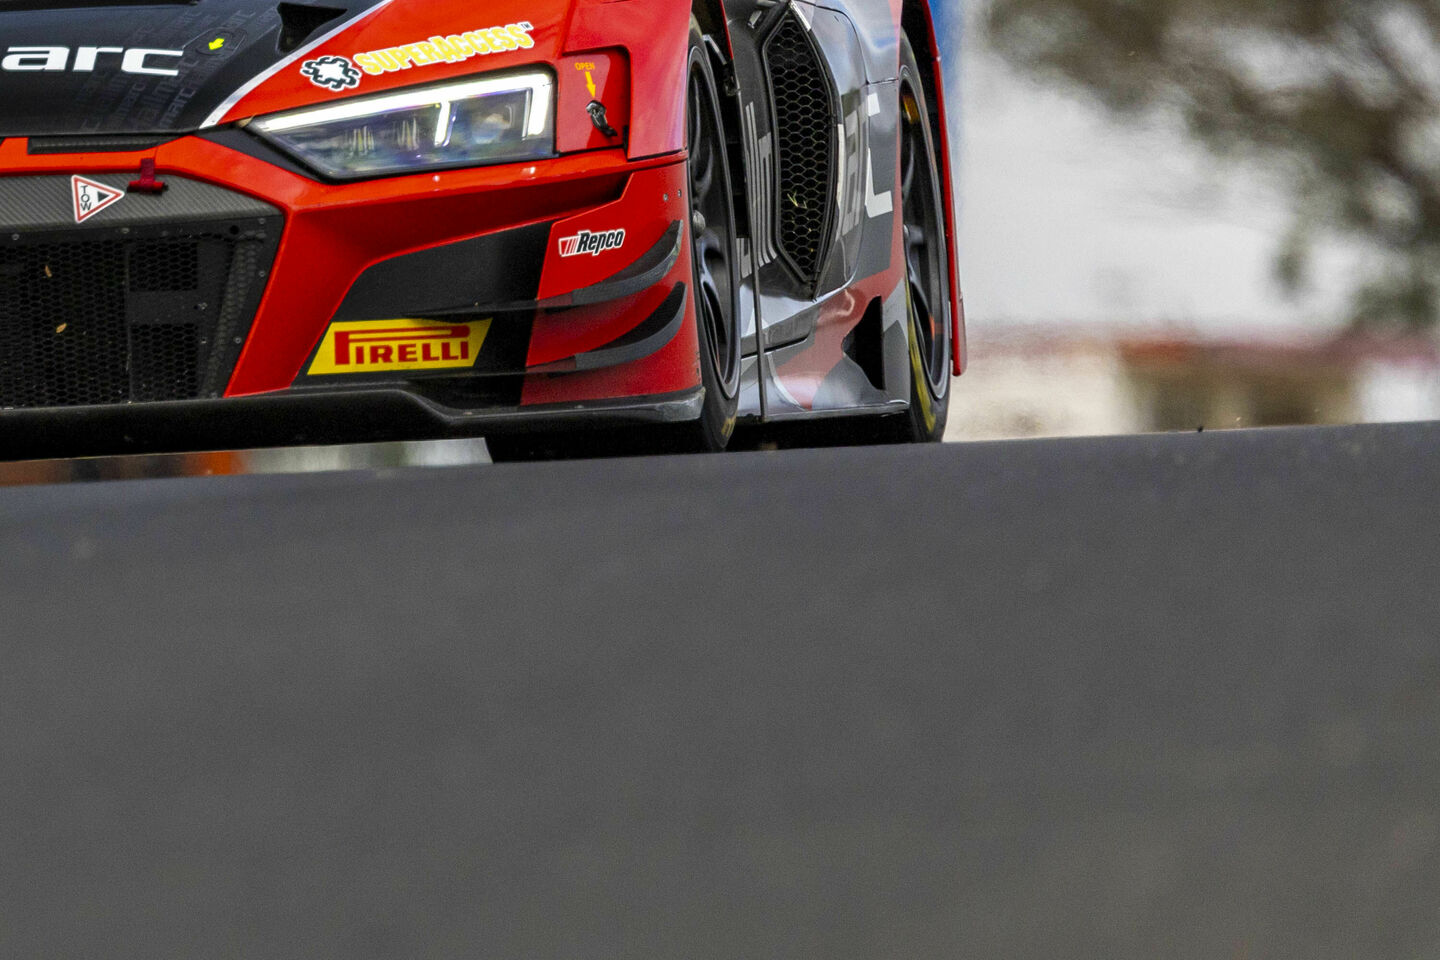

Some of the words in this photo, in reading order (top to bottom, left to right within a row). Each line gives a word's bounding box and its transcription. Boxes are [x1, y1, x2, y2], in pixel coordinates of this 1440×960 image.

[80, 185, 92, 211] TOW
[576, 230, 625, 255] Repco
[334, 324, 471, 366] PIRELLI
